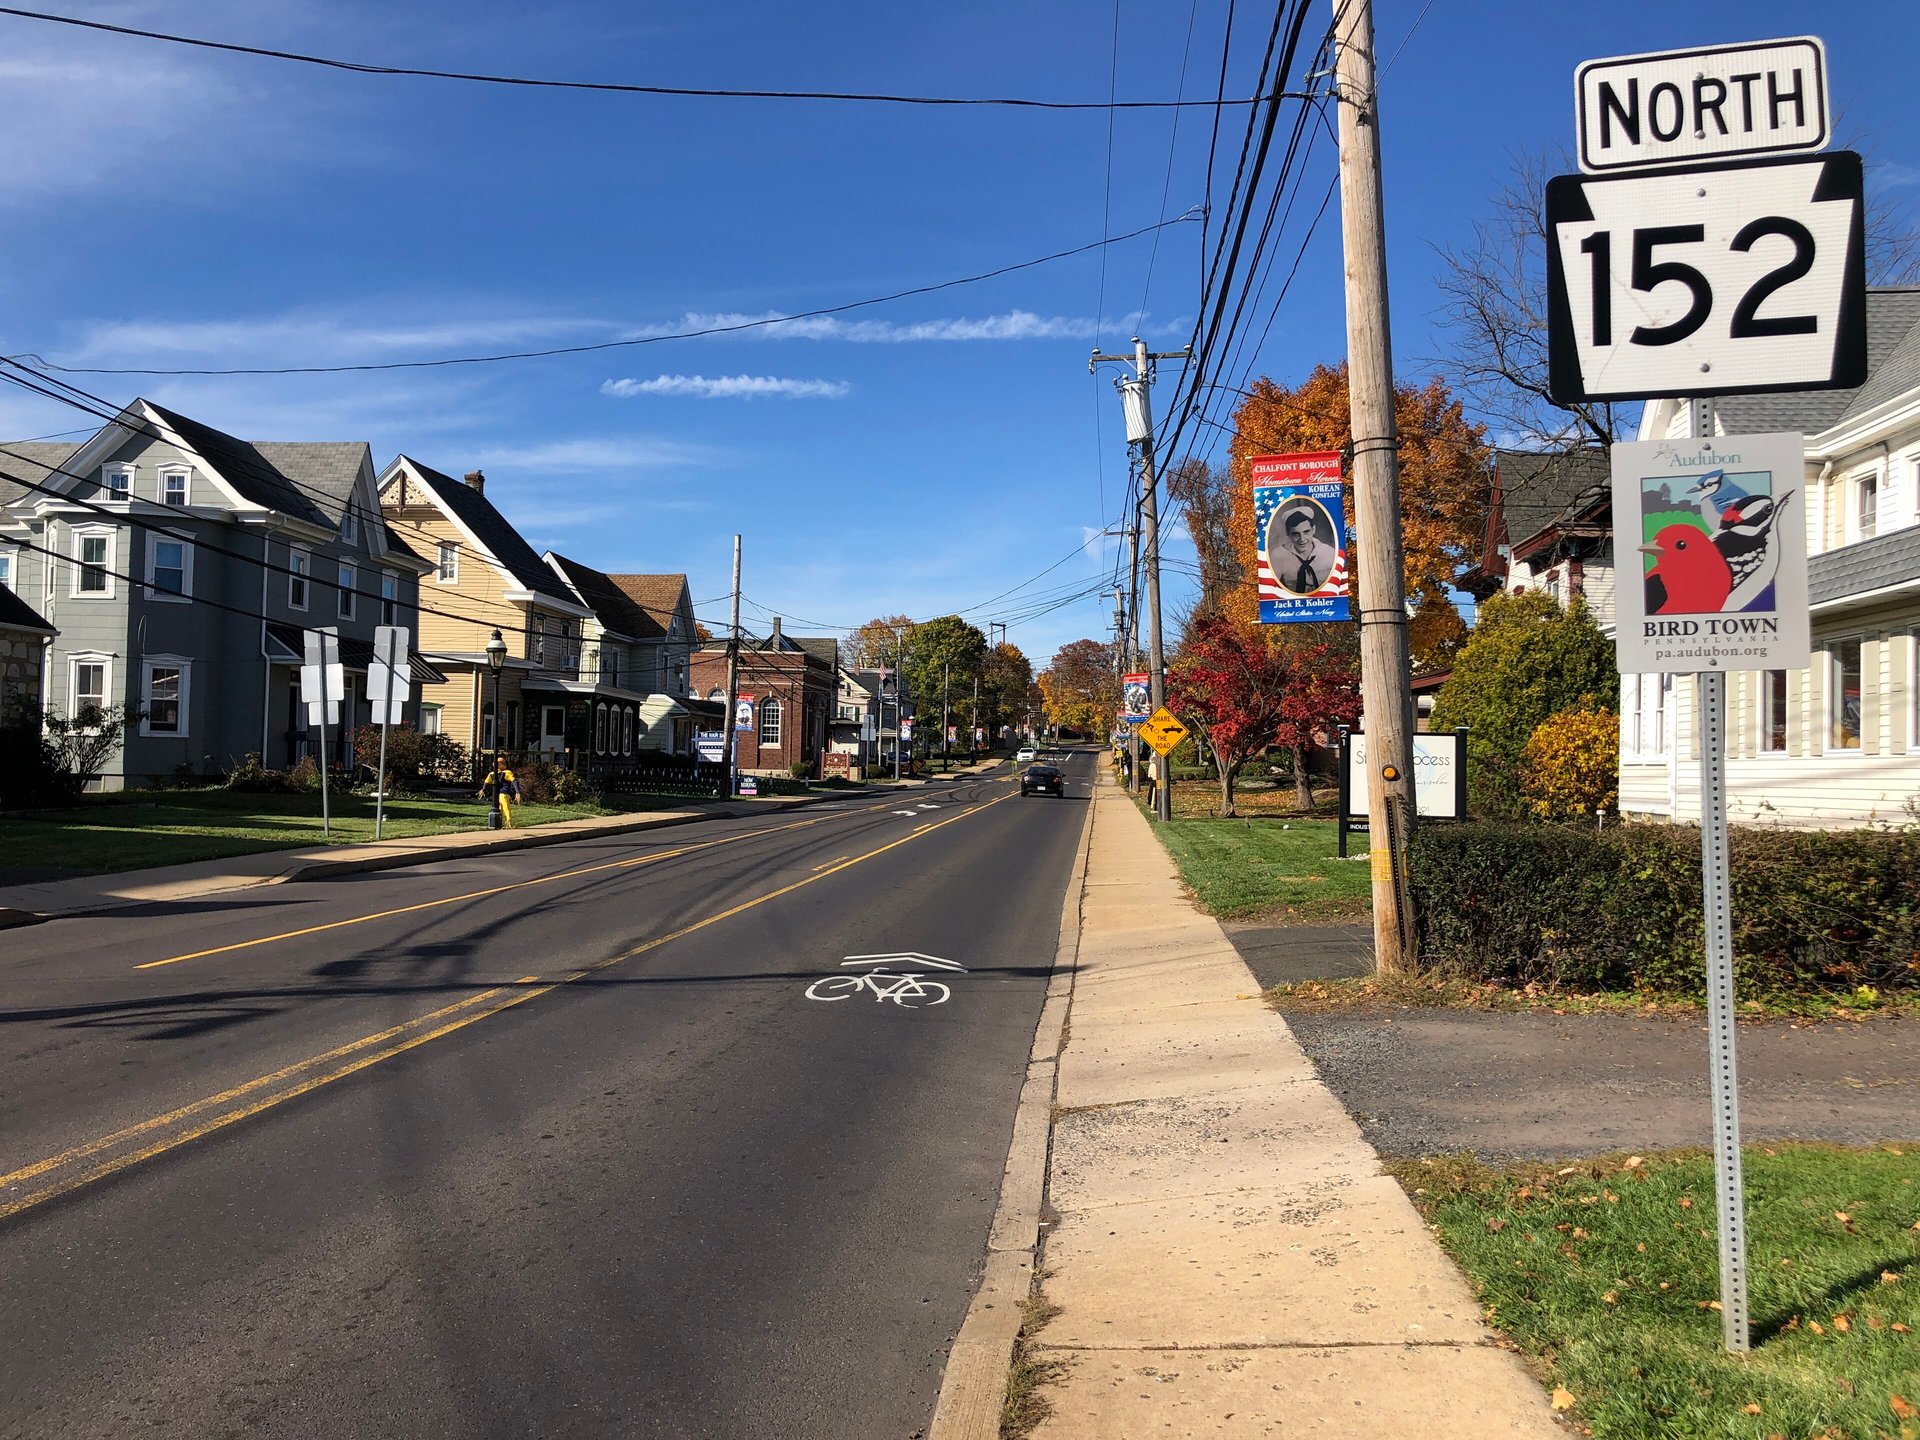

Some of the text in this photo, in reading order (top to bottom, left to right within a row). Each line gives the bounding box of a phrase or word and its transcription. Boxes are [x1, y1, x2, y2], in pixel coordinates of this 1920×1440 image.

[1598, 68, 1805, 149] NORTH
[1580, 216, 1818, 347] 152
[1669, 450, 1742, 467] Audubon
[1254, 459, 1339, 474] CHALFONT BOROUGH
[1254, 471, 1340, 486] Hometown Heroes
[1308, 484, 1340, 493] KOREAN
[1274, 598, 1335, 609] Jack R. Kohler
[1643, 618, 1779, 637] BIRD TOWN
[1644, 635, 1779, 646] PENNSYLVANIA
[1656, 646, 1768, 661] pa.audubon.org
[1412, 756, 1450, 766] ocess
